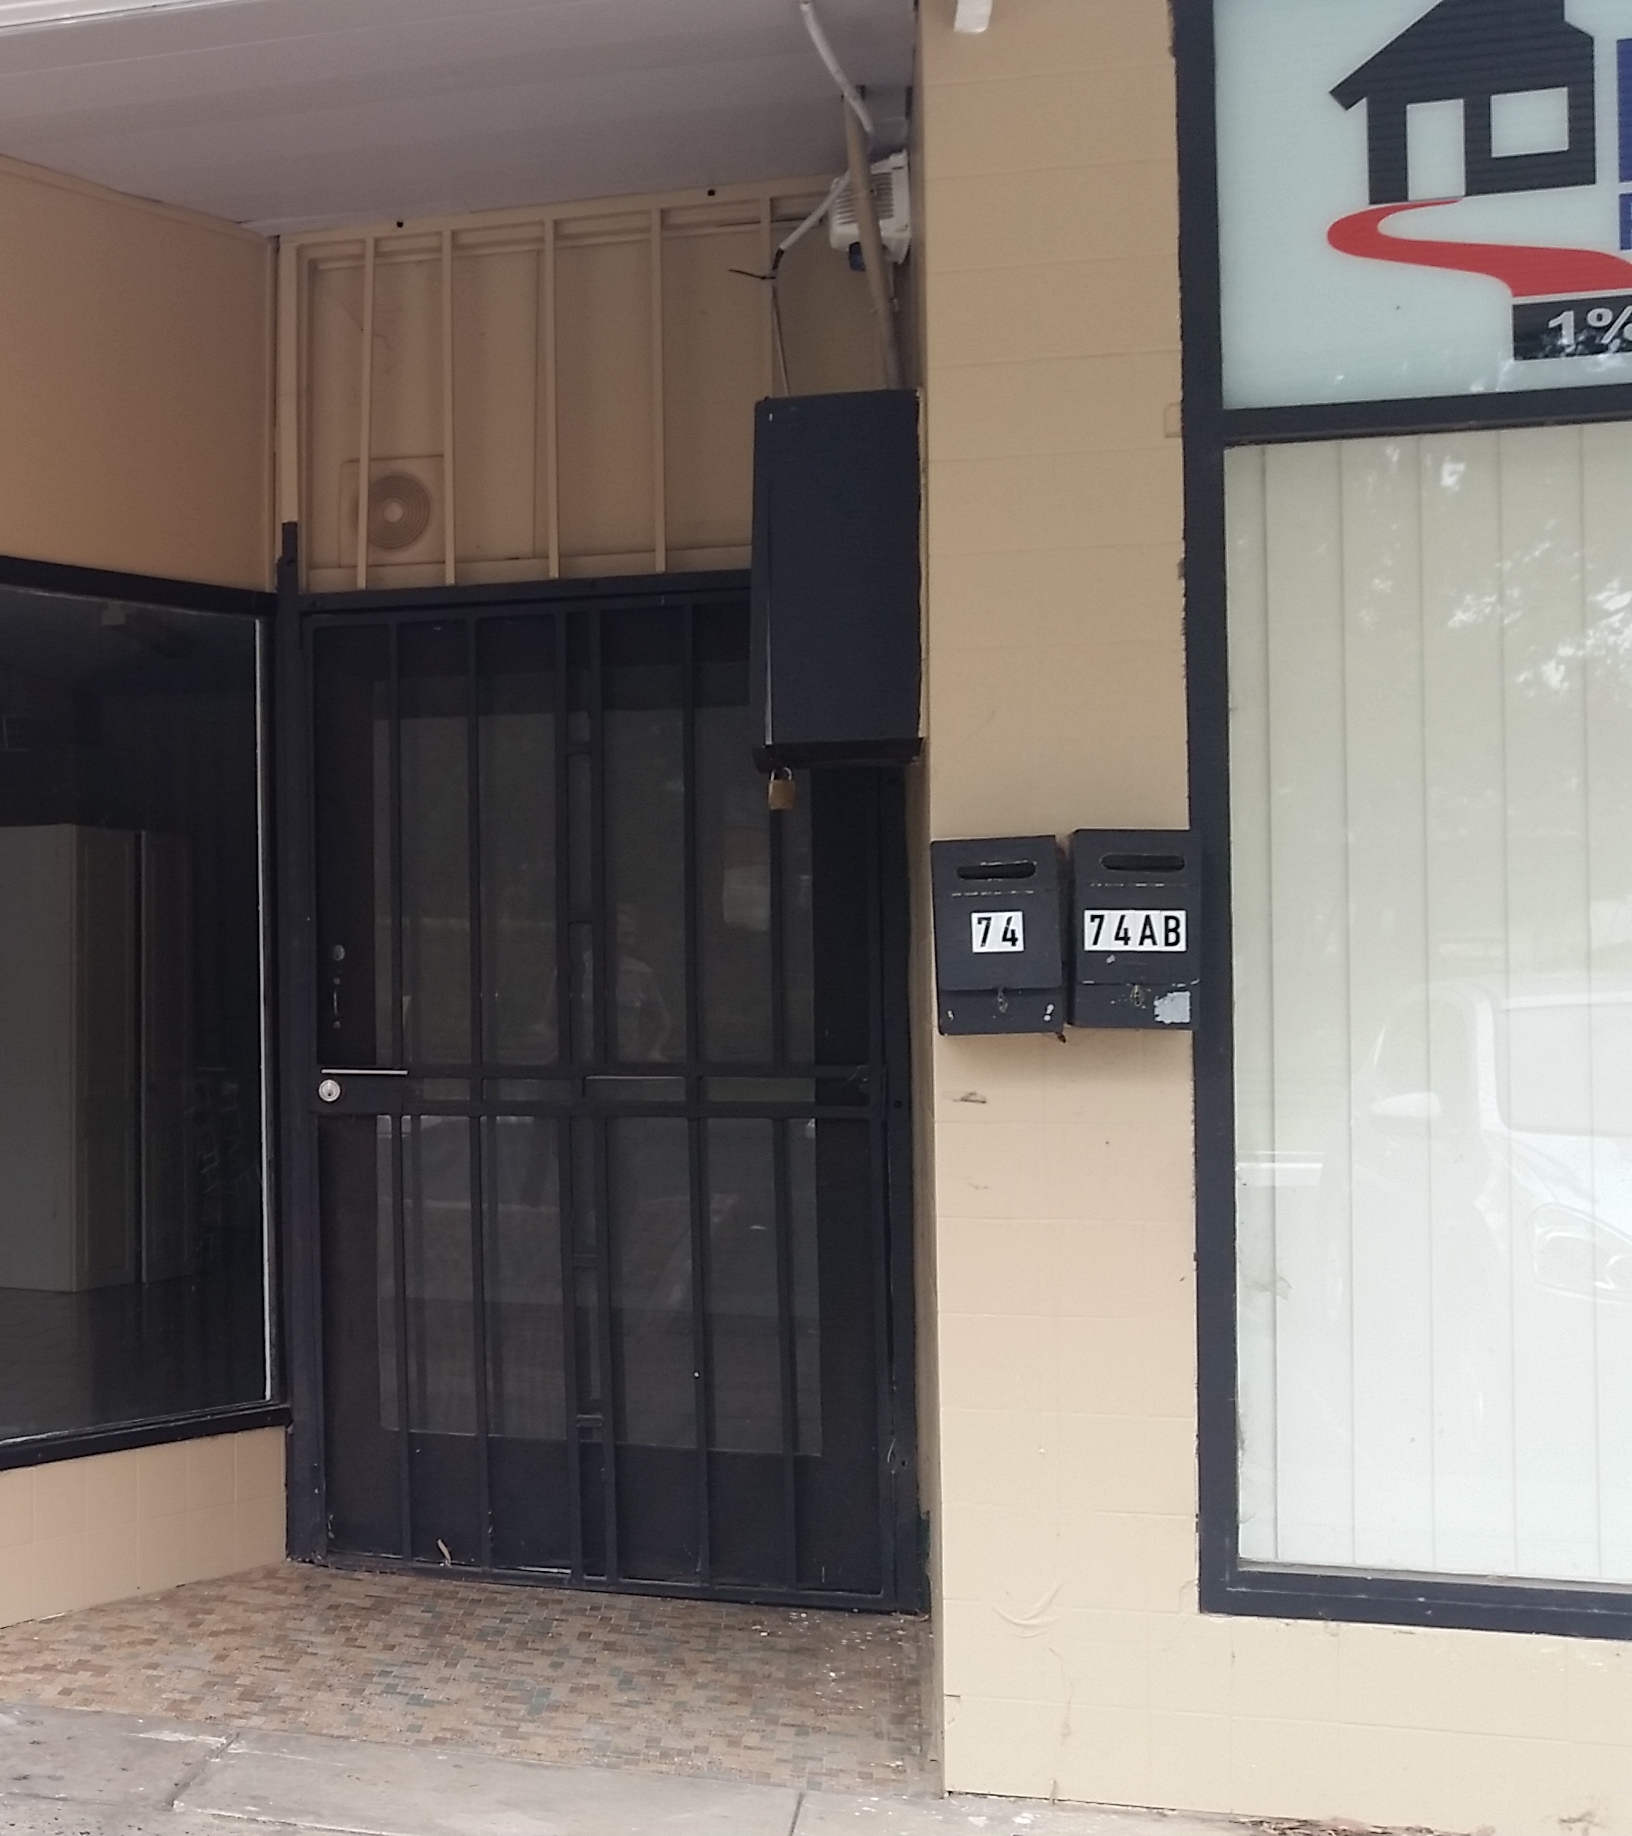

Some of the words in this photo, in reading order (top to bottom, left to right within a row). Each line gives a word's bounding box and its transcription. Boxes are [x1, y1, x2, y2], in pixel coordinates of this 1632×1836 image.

[1548, 305, 1632, 345] 1%
[977, 916, 1019, 947] 74
[1090, 914, 1181, 946] 74AB
